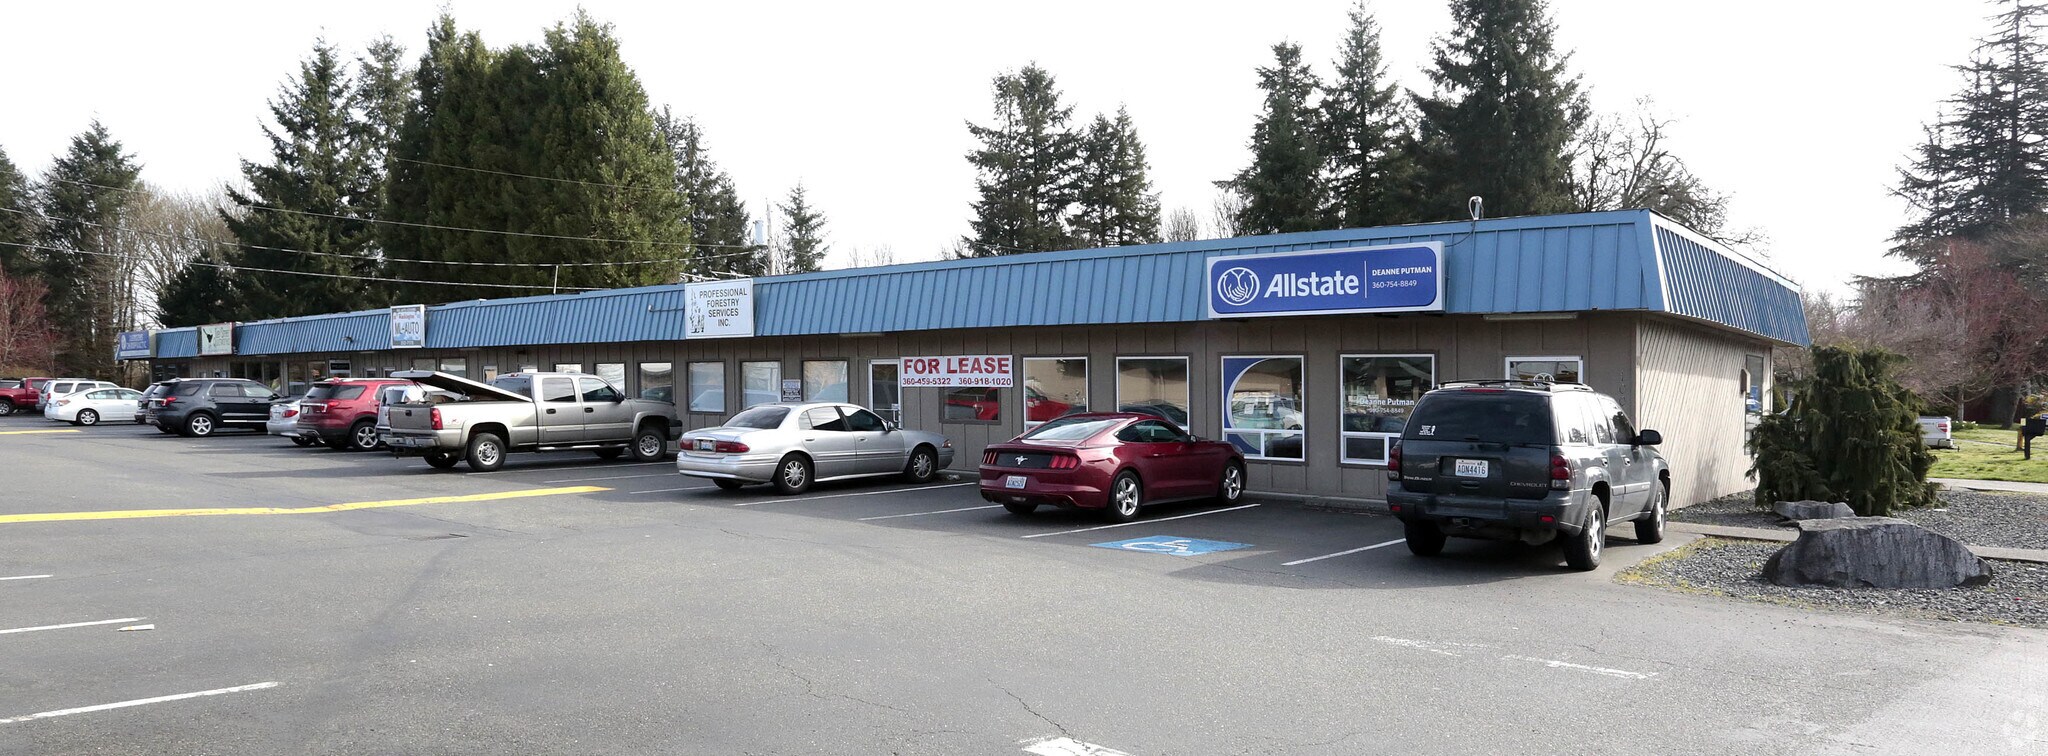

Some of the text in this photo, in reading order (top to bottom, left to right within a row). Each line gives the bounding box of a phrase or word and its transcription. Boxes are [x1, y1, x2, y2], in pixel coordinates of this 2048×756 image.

[1372, 266, 1432, 276] DEANNE PUTMAN
[1264, 270, 1359, 298] Allstate
[1372, 280, 1418, 289] 360-754-8849
[700, 288, 747, 298] PROFESSIONAL
[707, 298, 739, 308] FORESTRY
[708, 308, 739, 317] SERVICES
[718, 318, 730, 326] INC.
[903, 357, 1010, 375] FOR LEASE
[902, 377, 1012, 386] 360-459-5322 360-918-1020
[1387, 397, 1415, 406] Putman
